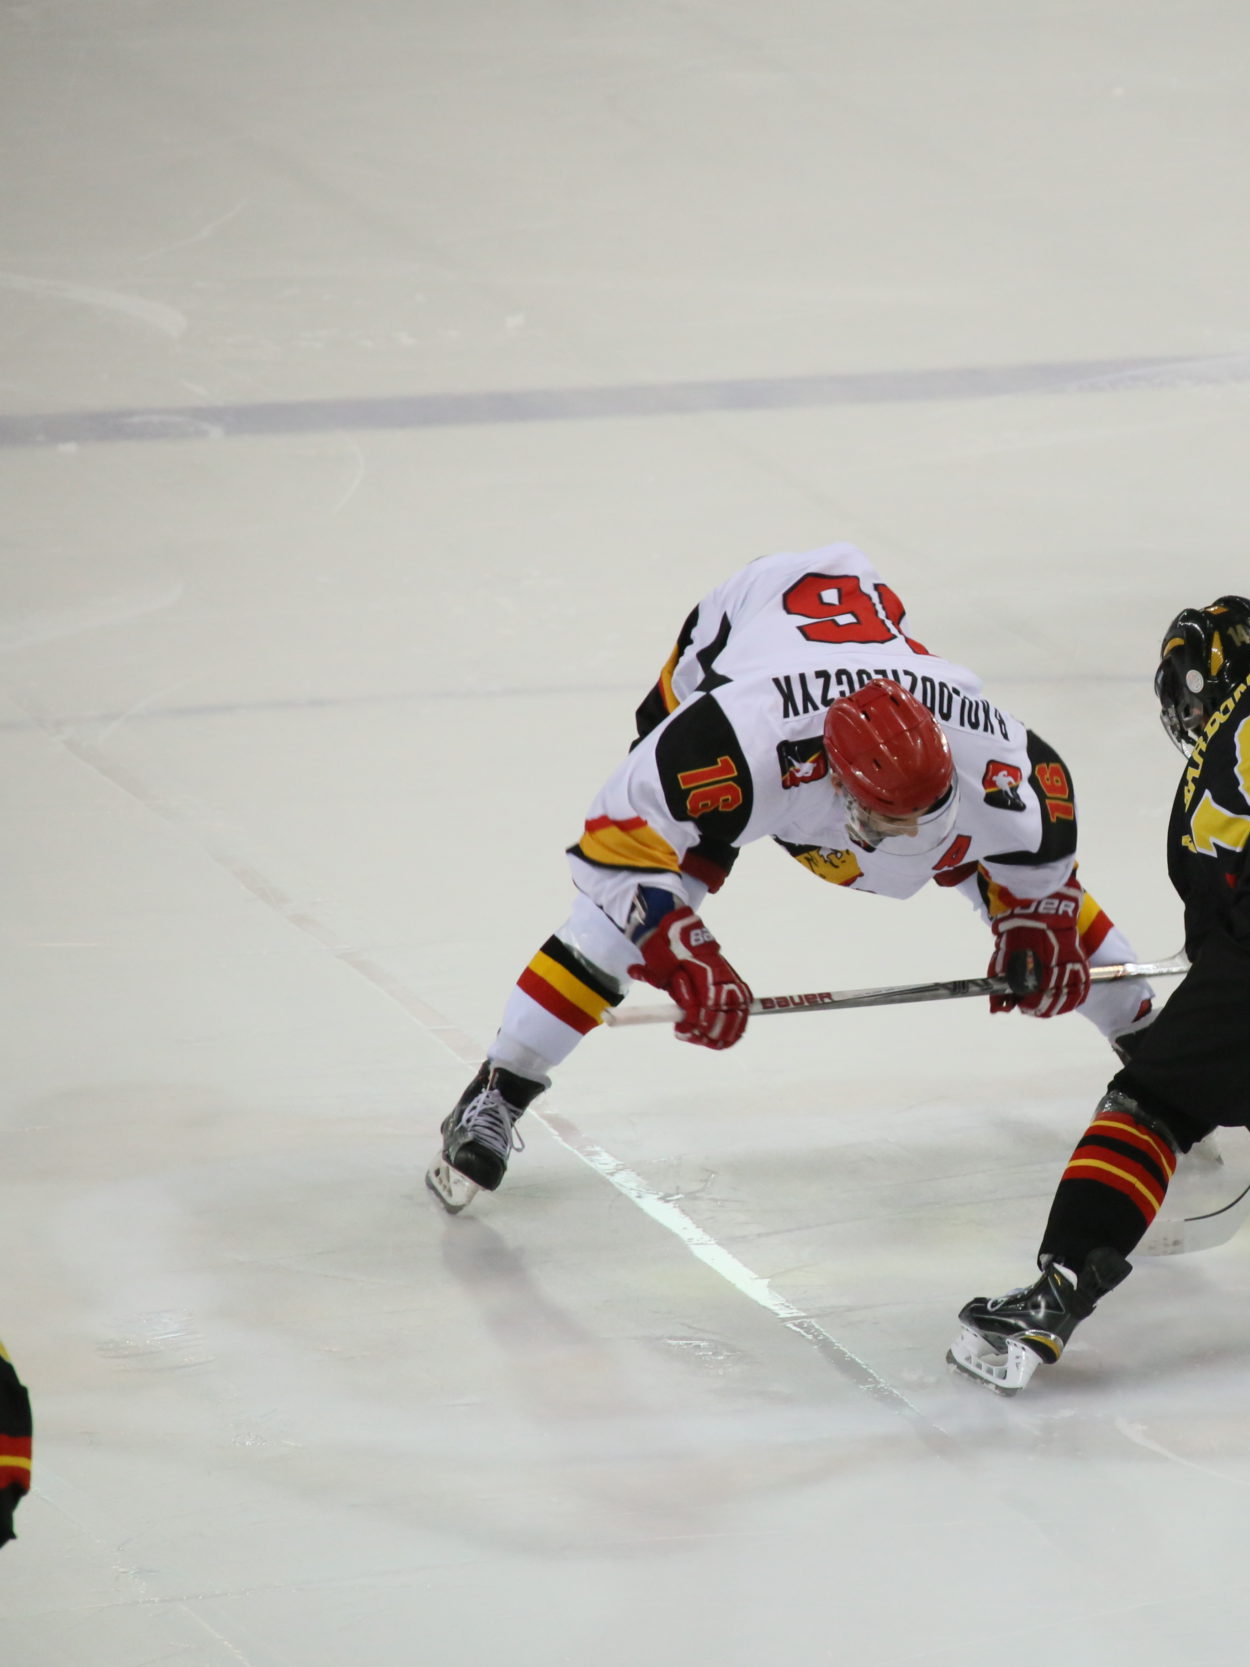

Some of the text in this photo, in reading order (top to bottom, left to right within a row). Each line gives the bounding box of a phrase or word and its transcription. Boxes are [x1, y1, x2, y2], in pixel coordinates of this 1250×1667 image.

[677, 755, 743, 819] 16
[1035, 763, 1075, 823] 16
[931, 834, 972, 871] A
[762, 992, 835, 1010] BAUER
